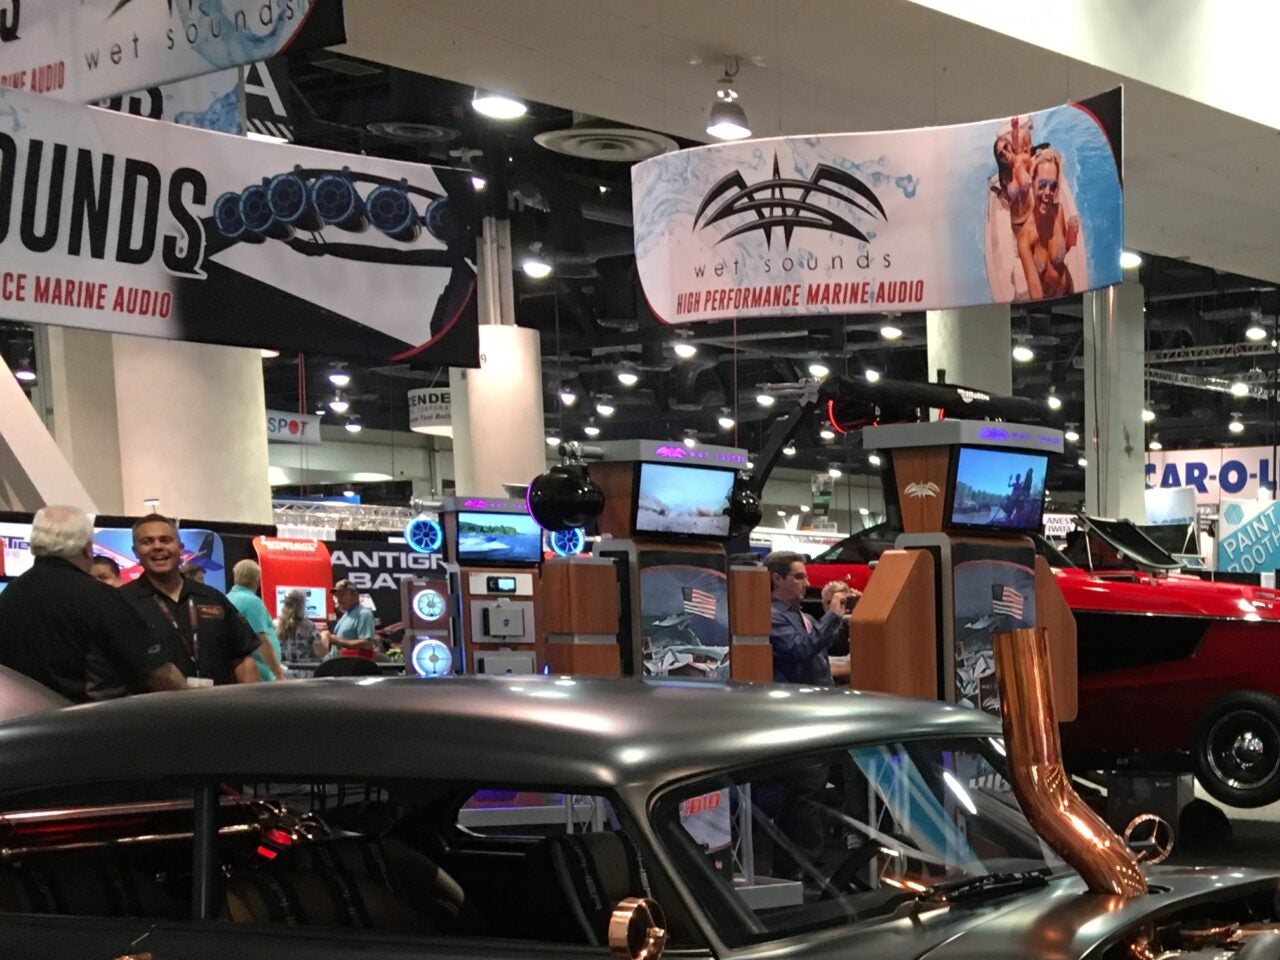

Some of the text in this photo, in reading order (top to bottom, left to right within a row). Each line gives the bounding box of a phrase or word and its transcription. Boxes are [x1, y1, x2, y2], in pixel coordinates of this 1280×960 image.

[85, 0, 294, 71] wet sounds
[30, 61, 65, 93] AUDIO
[694, 252, 892, 278] wet sounds
[34, 275, 108, 310] MARINE
[112, 286, 173, 318] AUDIO
[676, 279, 924, 315] HIGH PERFORMANCE MARINE AUDIO
[1223, 506, 1277, 560] PAINT
